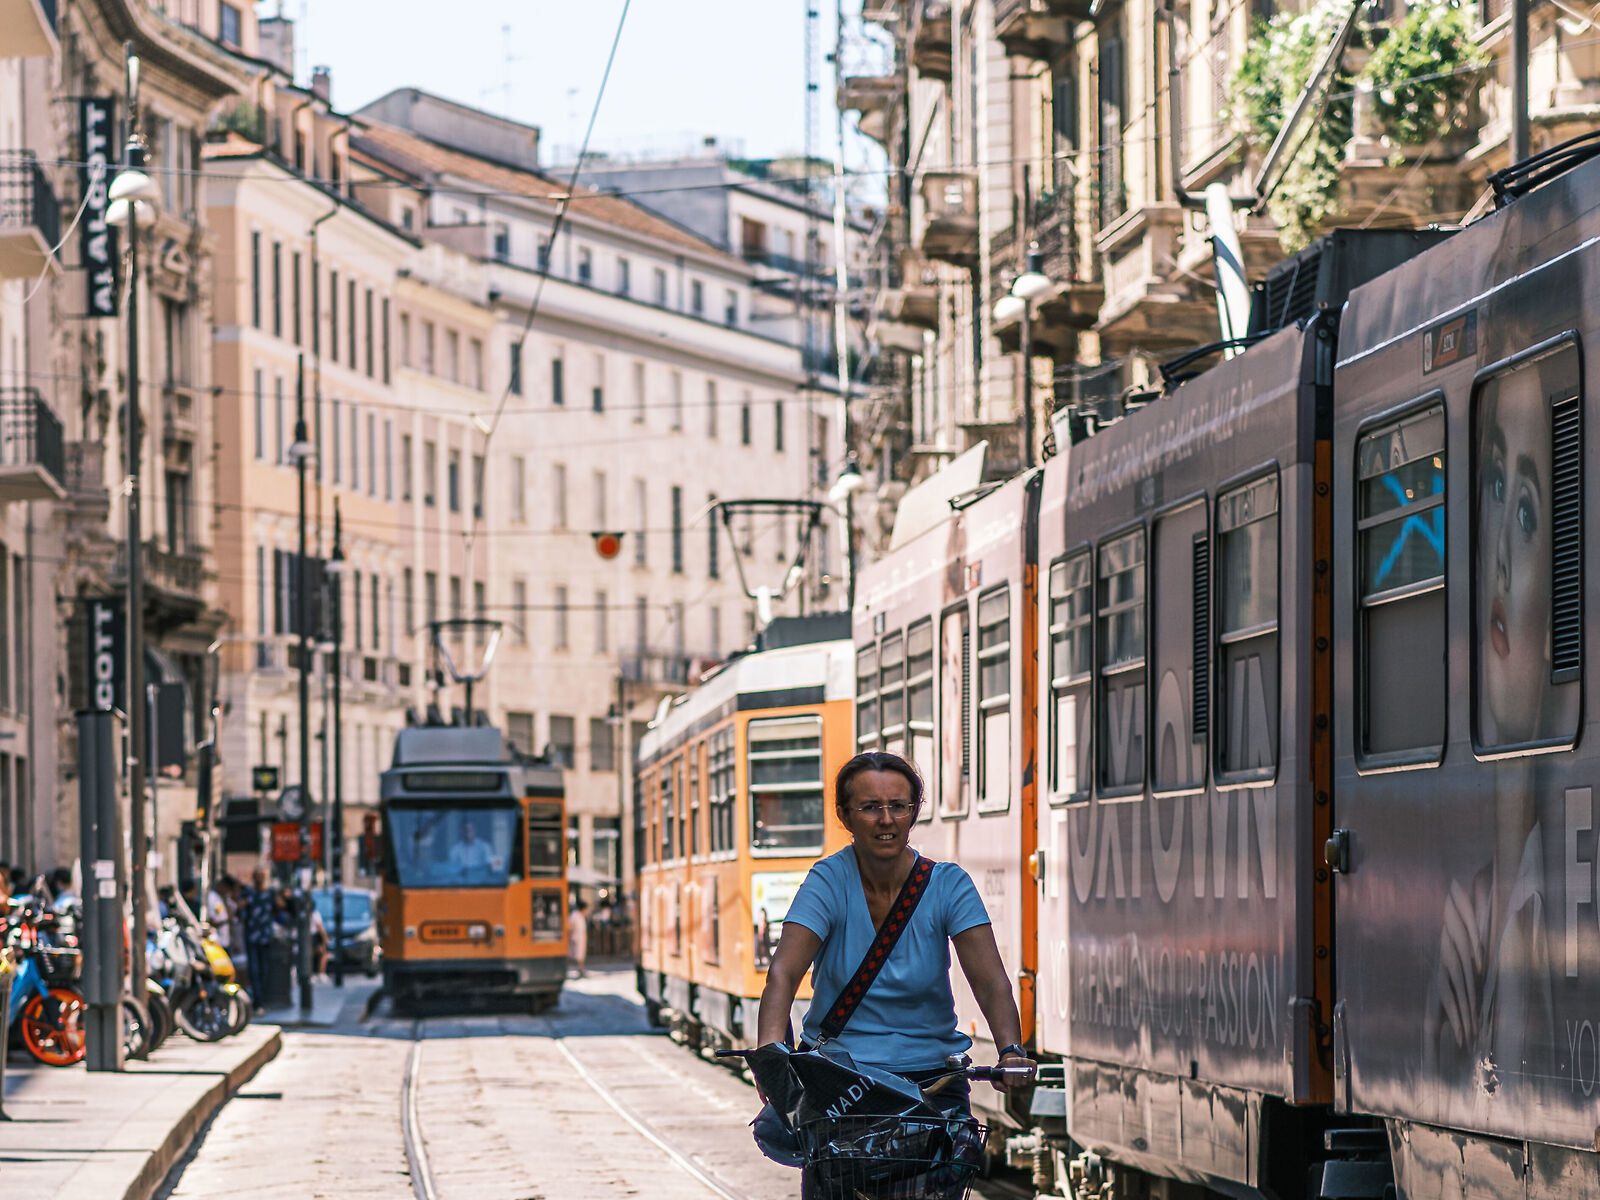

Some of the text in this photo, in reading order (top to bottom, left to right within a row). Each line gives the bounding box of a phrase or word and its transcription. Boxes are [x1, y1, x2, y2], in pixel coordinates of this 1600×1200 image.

[1564, 786, 1600, 978] F
[1158, 947, 1194, 1038] OUR
[1198, 949, 1278, 1050] PASSION
[1565, 1020, 1600, 1097] YO
